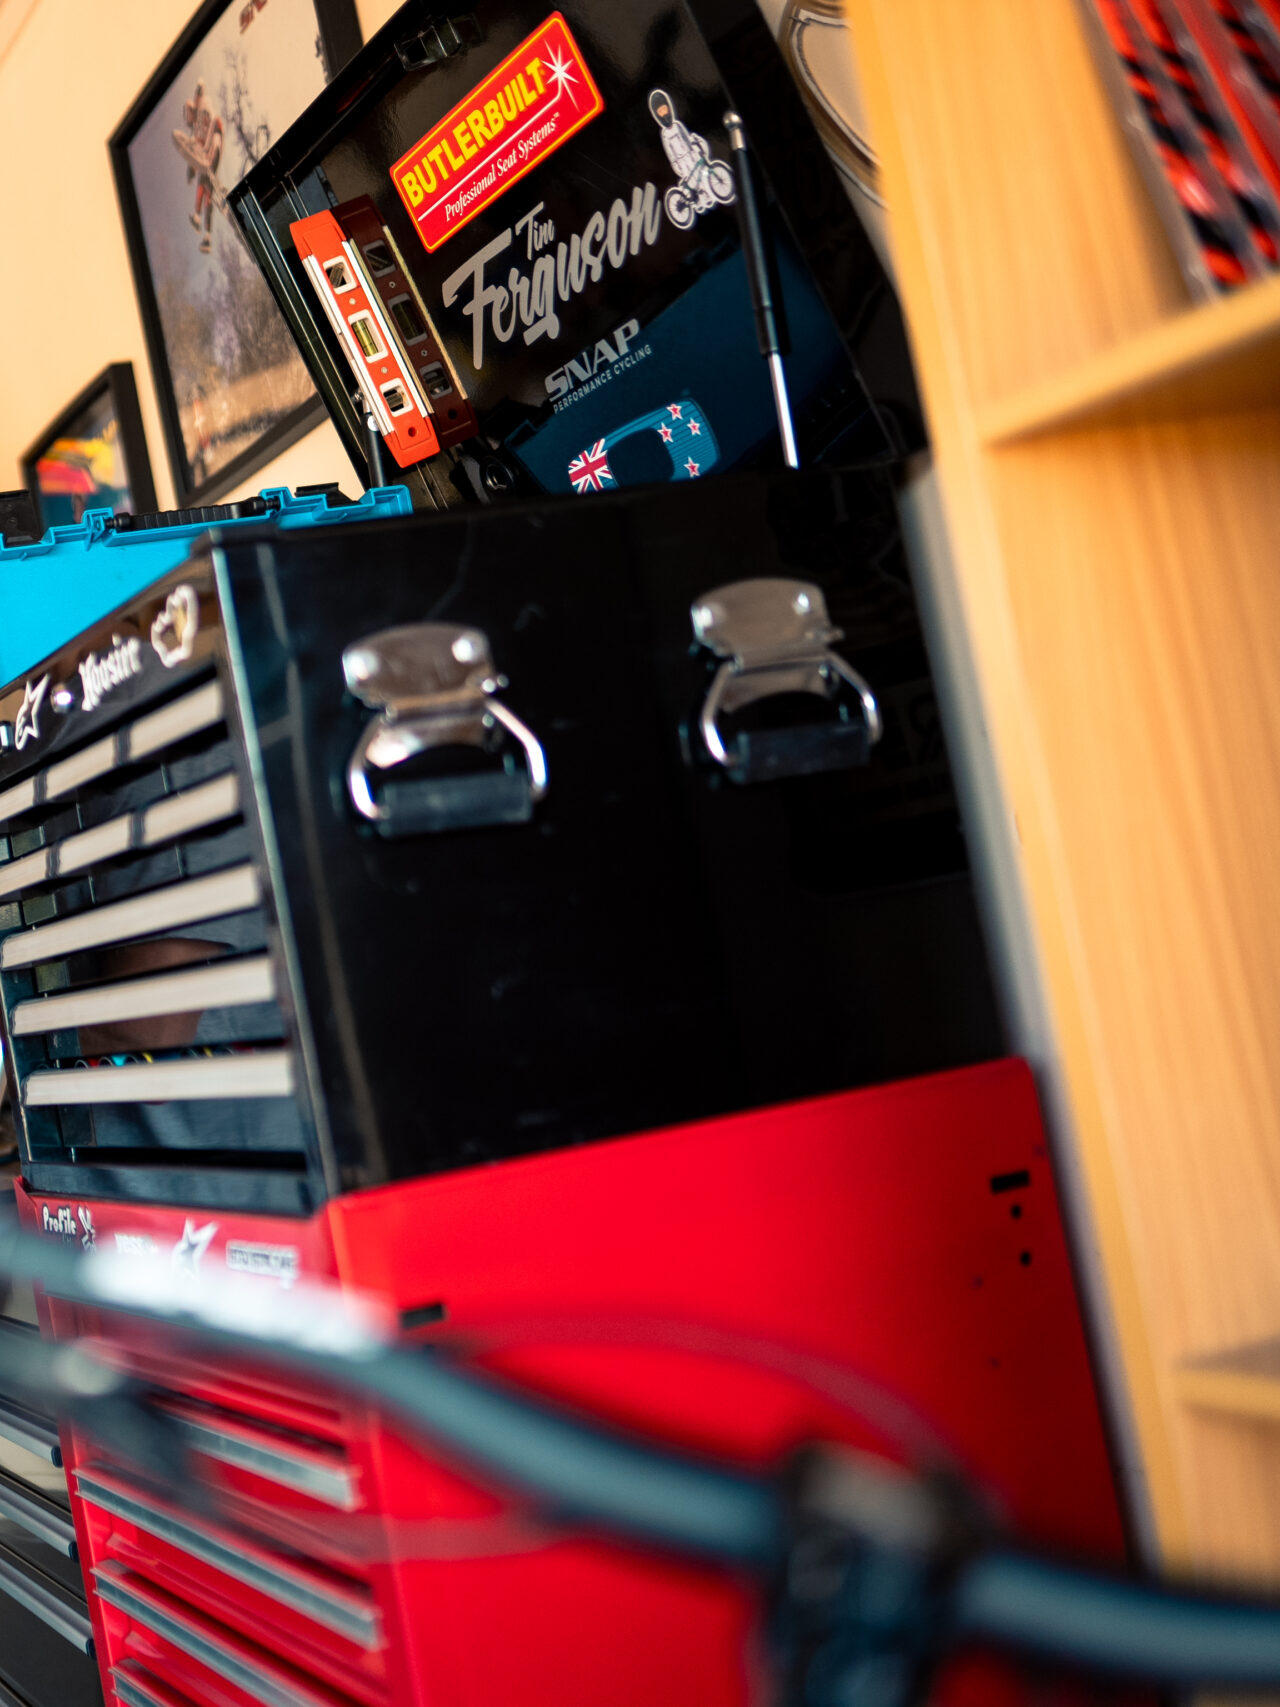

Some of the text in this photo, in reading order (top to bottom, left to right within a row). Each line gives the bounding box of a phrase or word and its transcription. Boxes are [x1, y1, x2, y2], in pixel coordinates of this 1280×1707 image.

[401, 56, 546, 208] BUTLERBUILT
[445, 163, 496, 221] Professional
[497, 148, 518, 177] Seat
[516, 201, 555, 260] Tim
[442, 182, 661, 370] Ferguson
[544, 318, 640, 402] SNAP
[553, 344, 652, 414] PERFORMANCE CYCLING
